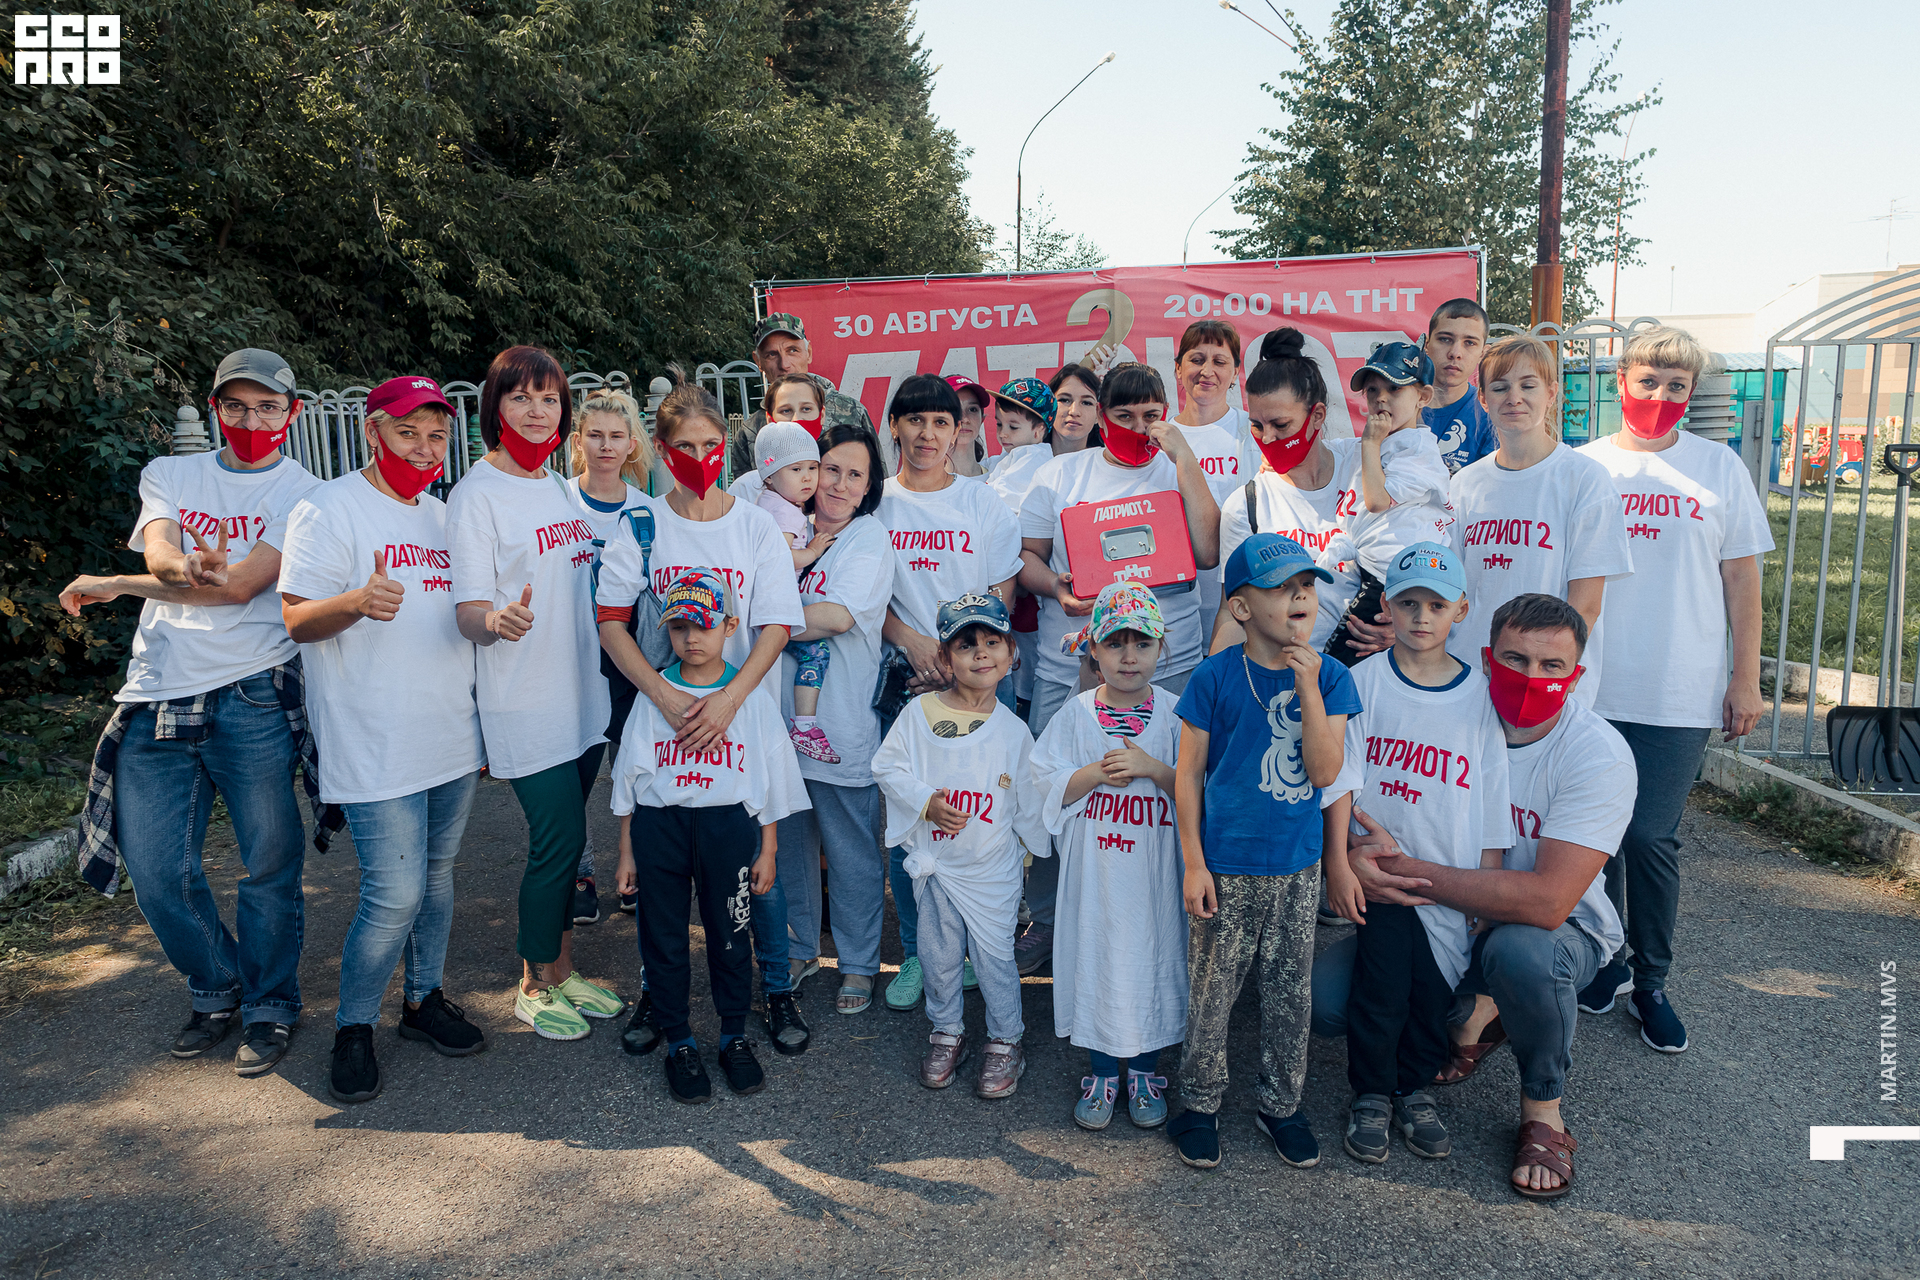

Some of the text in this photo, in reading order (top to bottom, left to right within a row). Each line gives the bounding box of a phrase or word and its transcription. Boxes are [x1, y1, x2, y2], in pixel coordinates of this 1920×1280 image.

[1163, 288, 1423, 318] 20:00 НА ТНТ
[833, 304, 1038, 338] 30 АВГУСТА
[1093, 499, 1156, 524] ПАТРИОТ 2
[1621, 493, 1704, 521] РИОТ 2
[535, 519, 598, 556] ПАТРИО
[958, 530, 974, 554] 2
[1537, 521, 1554, 550] 2
[909, 557, 940, 572] ТНТ
[1257, 542, 1311, 564] RUSSIA
[1483, 553, 1513, 570] ТНТ
[422, 575, 453, 592] ТНТ
[814, 569, 827, 596] 2
[1113, 563, 1153, 582] ТНТ
[737, 743, 745, 773] 2
[674, 770, 714, 790] ТНТ
[1455, 754, 1470, 790] 2
[1379, 779, 1423, 805] ТНТ
[979, 792, 993, 825] 2
[1077, 790, 1173, 828] АТРИОТ 2
[1527, 809, 1541, 839] 2
[1097, 832, 1136, 853] ТНТ
